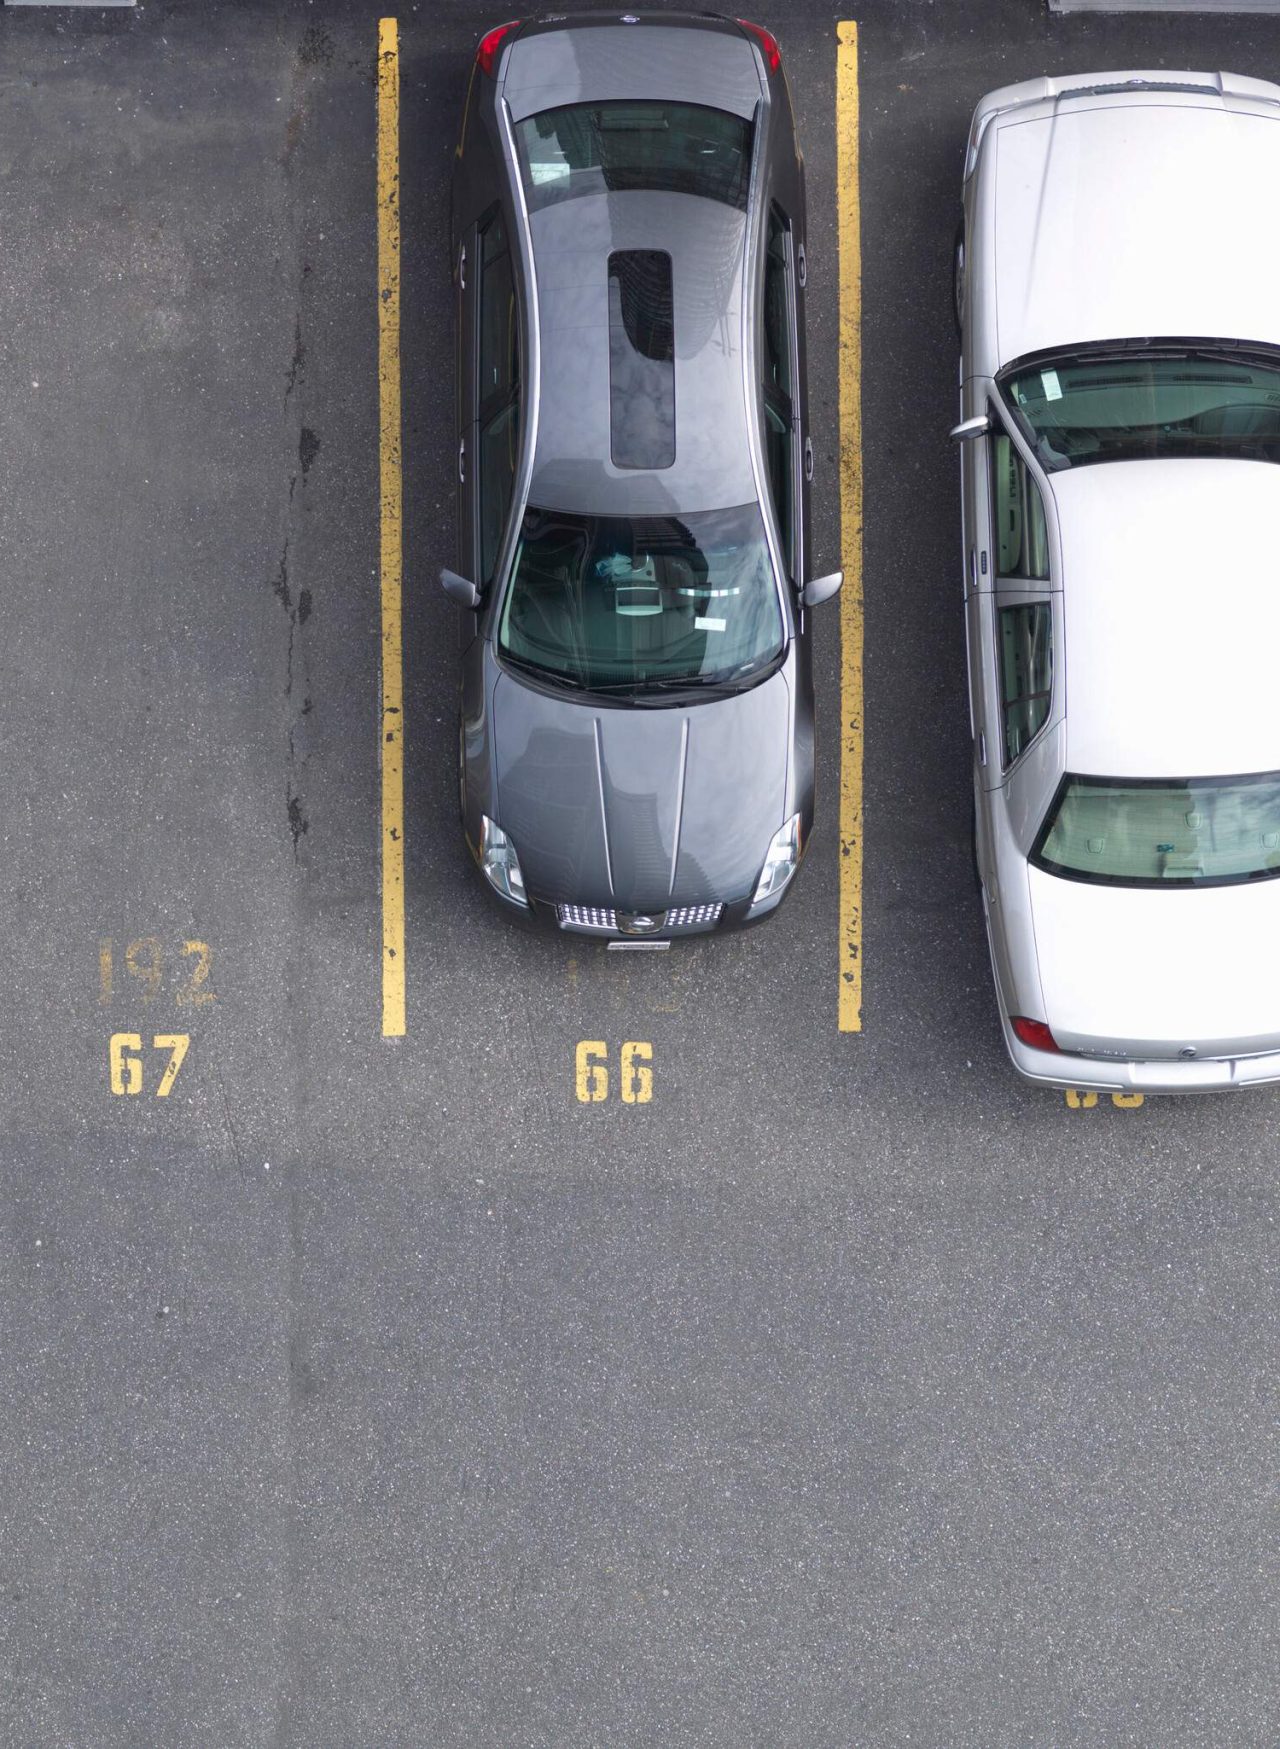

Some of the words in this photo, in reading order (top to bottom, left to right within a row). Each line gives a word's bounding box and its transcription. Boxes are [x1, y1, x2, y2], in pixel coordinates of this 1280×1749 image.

[99, 938, 218, 1006] 192
[110, 1033, 190, 1096] 67
[576, 1040, 653, 1103] 66
